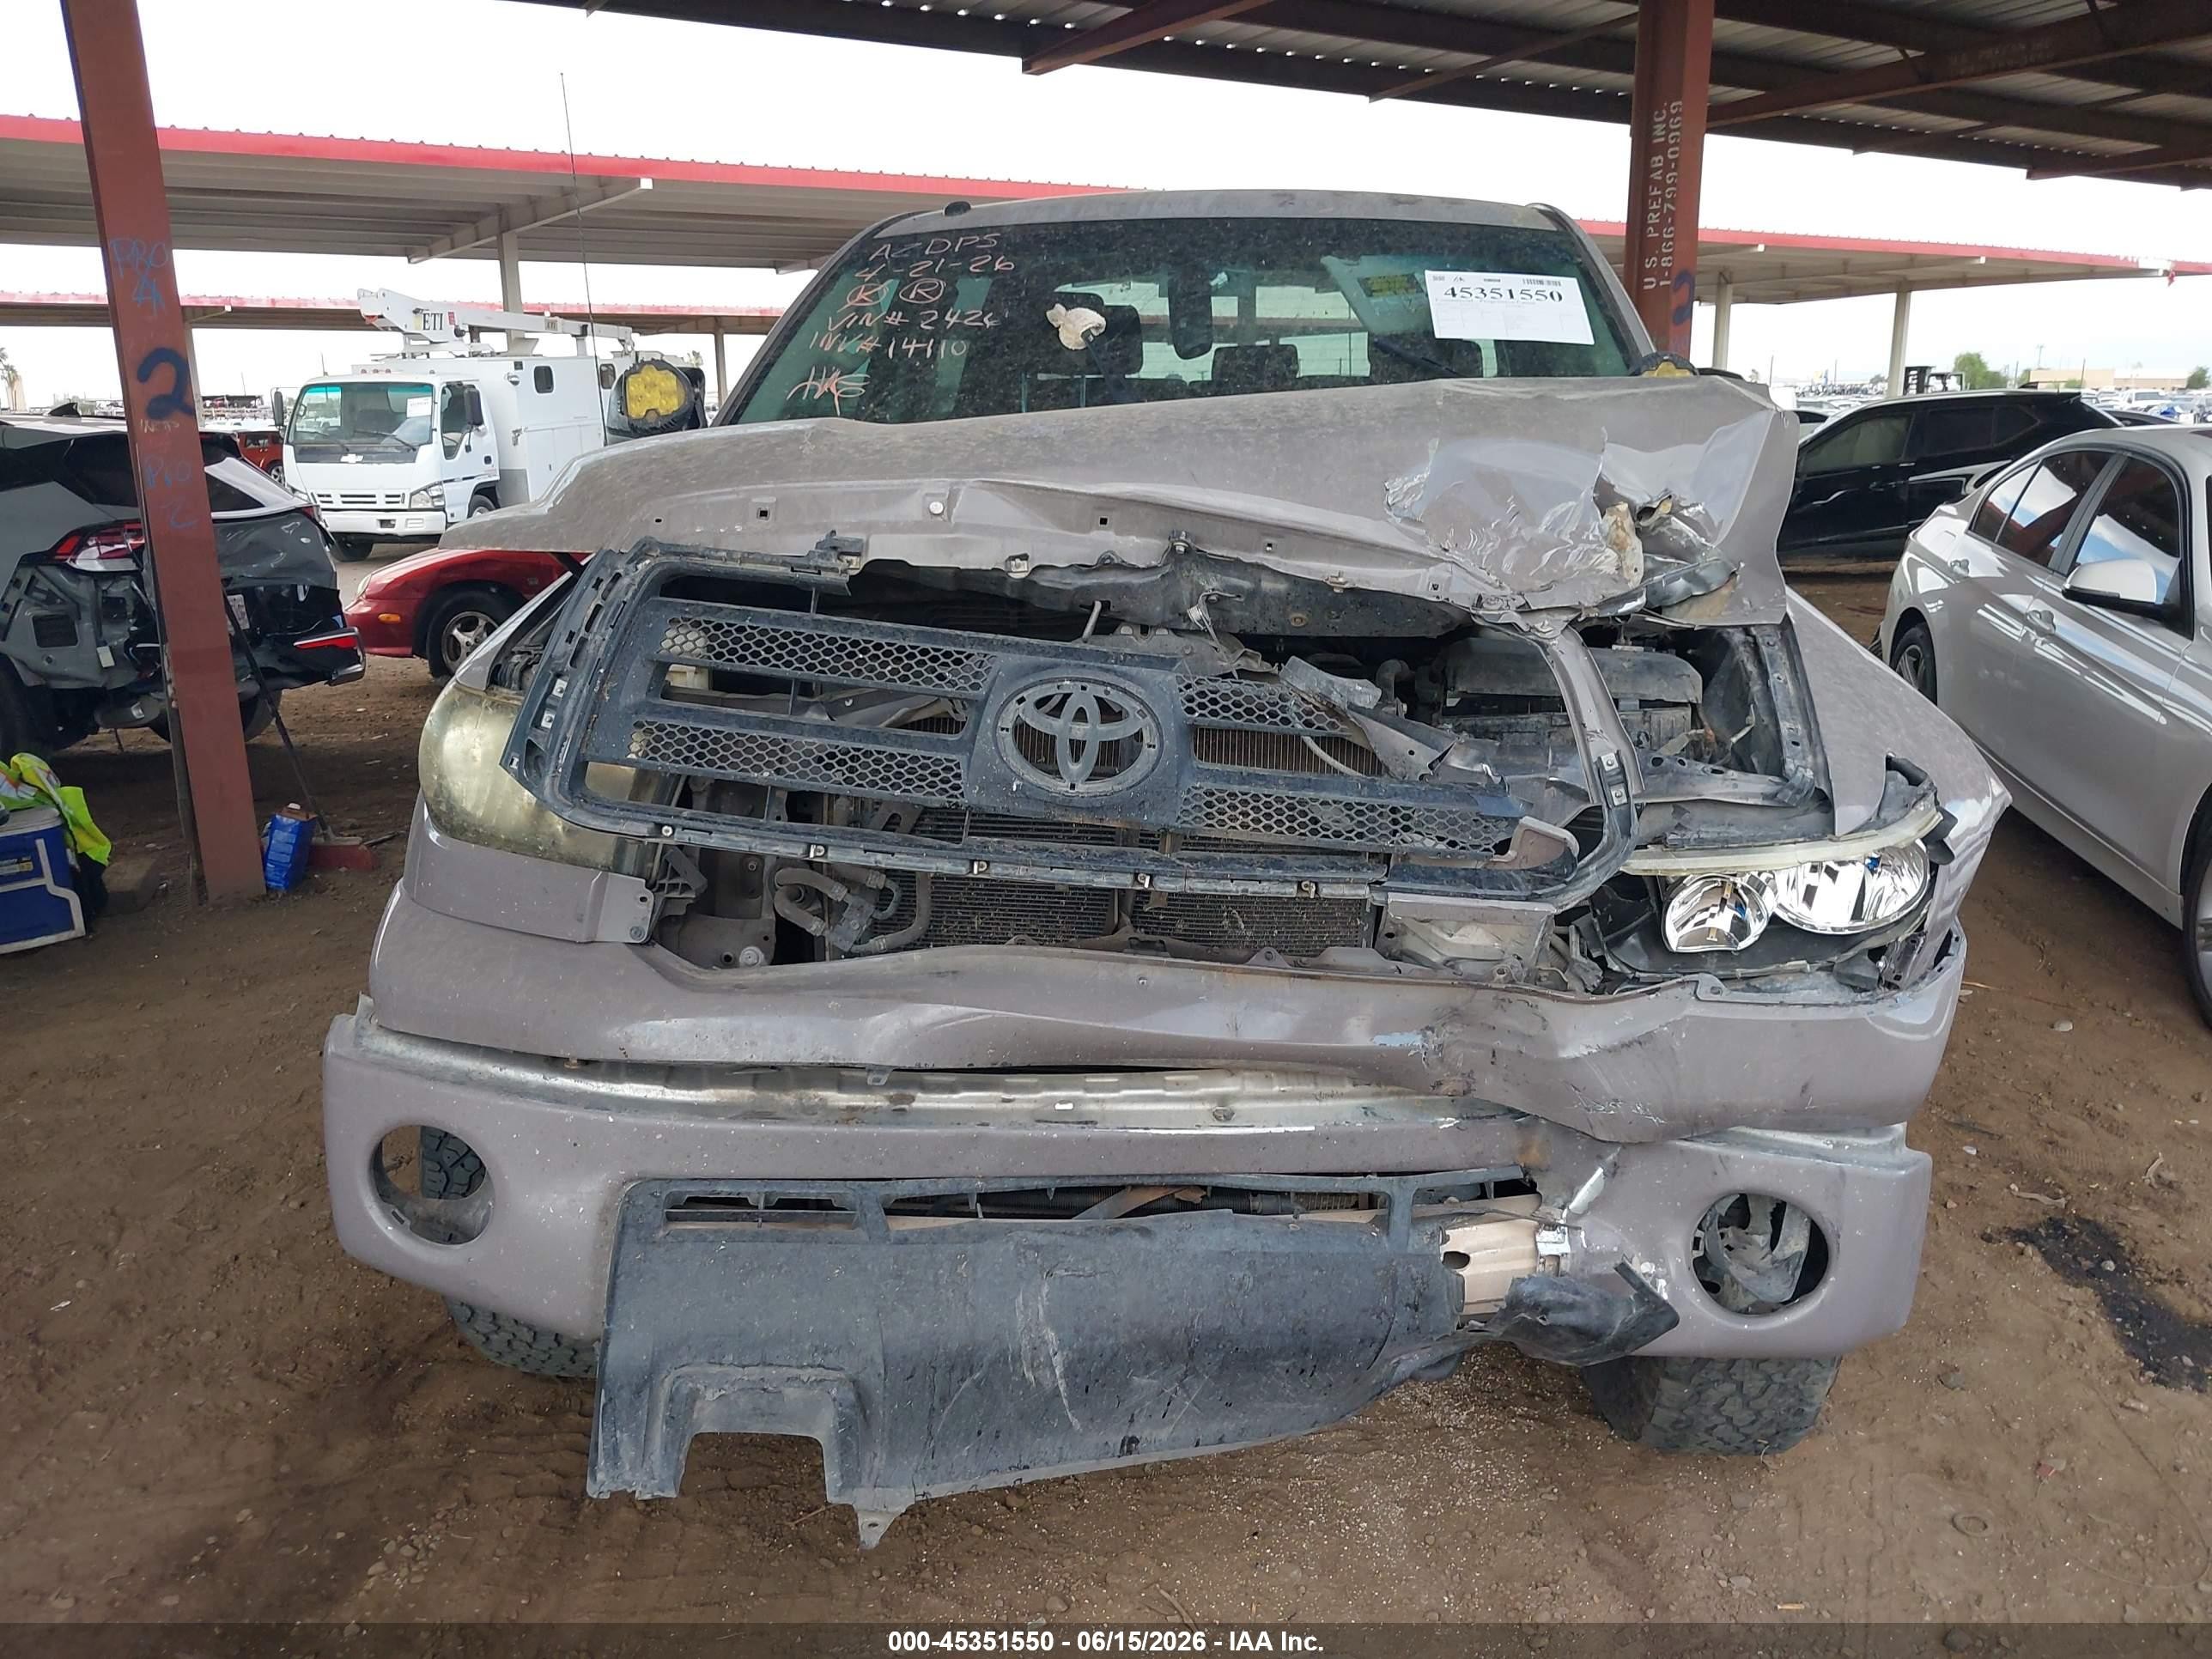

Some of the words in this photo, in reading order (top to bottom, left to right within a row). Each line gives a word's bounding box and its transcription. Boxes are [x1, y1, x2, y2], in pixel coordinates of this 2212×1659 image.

[1652, 101, 1668, 143] INC.
[1646, 155, 1664, 238] PREFAB
[1659, 100, 1683, 287] 1-866-799-0969
[924, 233, 1000, 255] DPS
[854, 254, 1015, 281] 4-21-26
[1444, 286, 1563, 302] 45351550
[422, 313, 443, 331] ETI
[888, 337, 967, 359] 14110
[137, 348, 192, 421] 2
